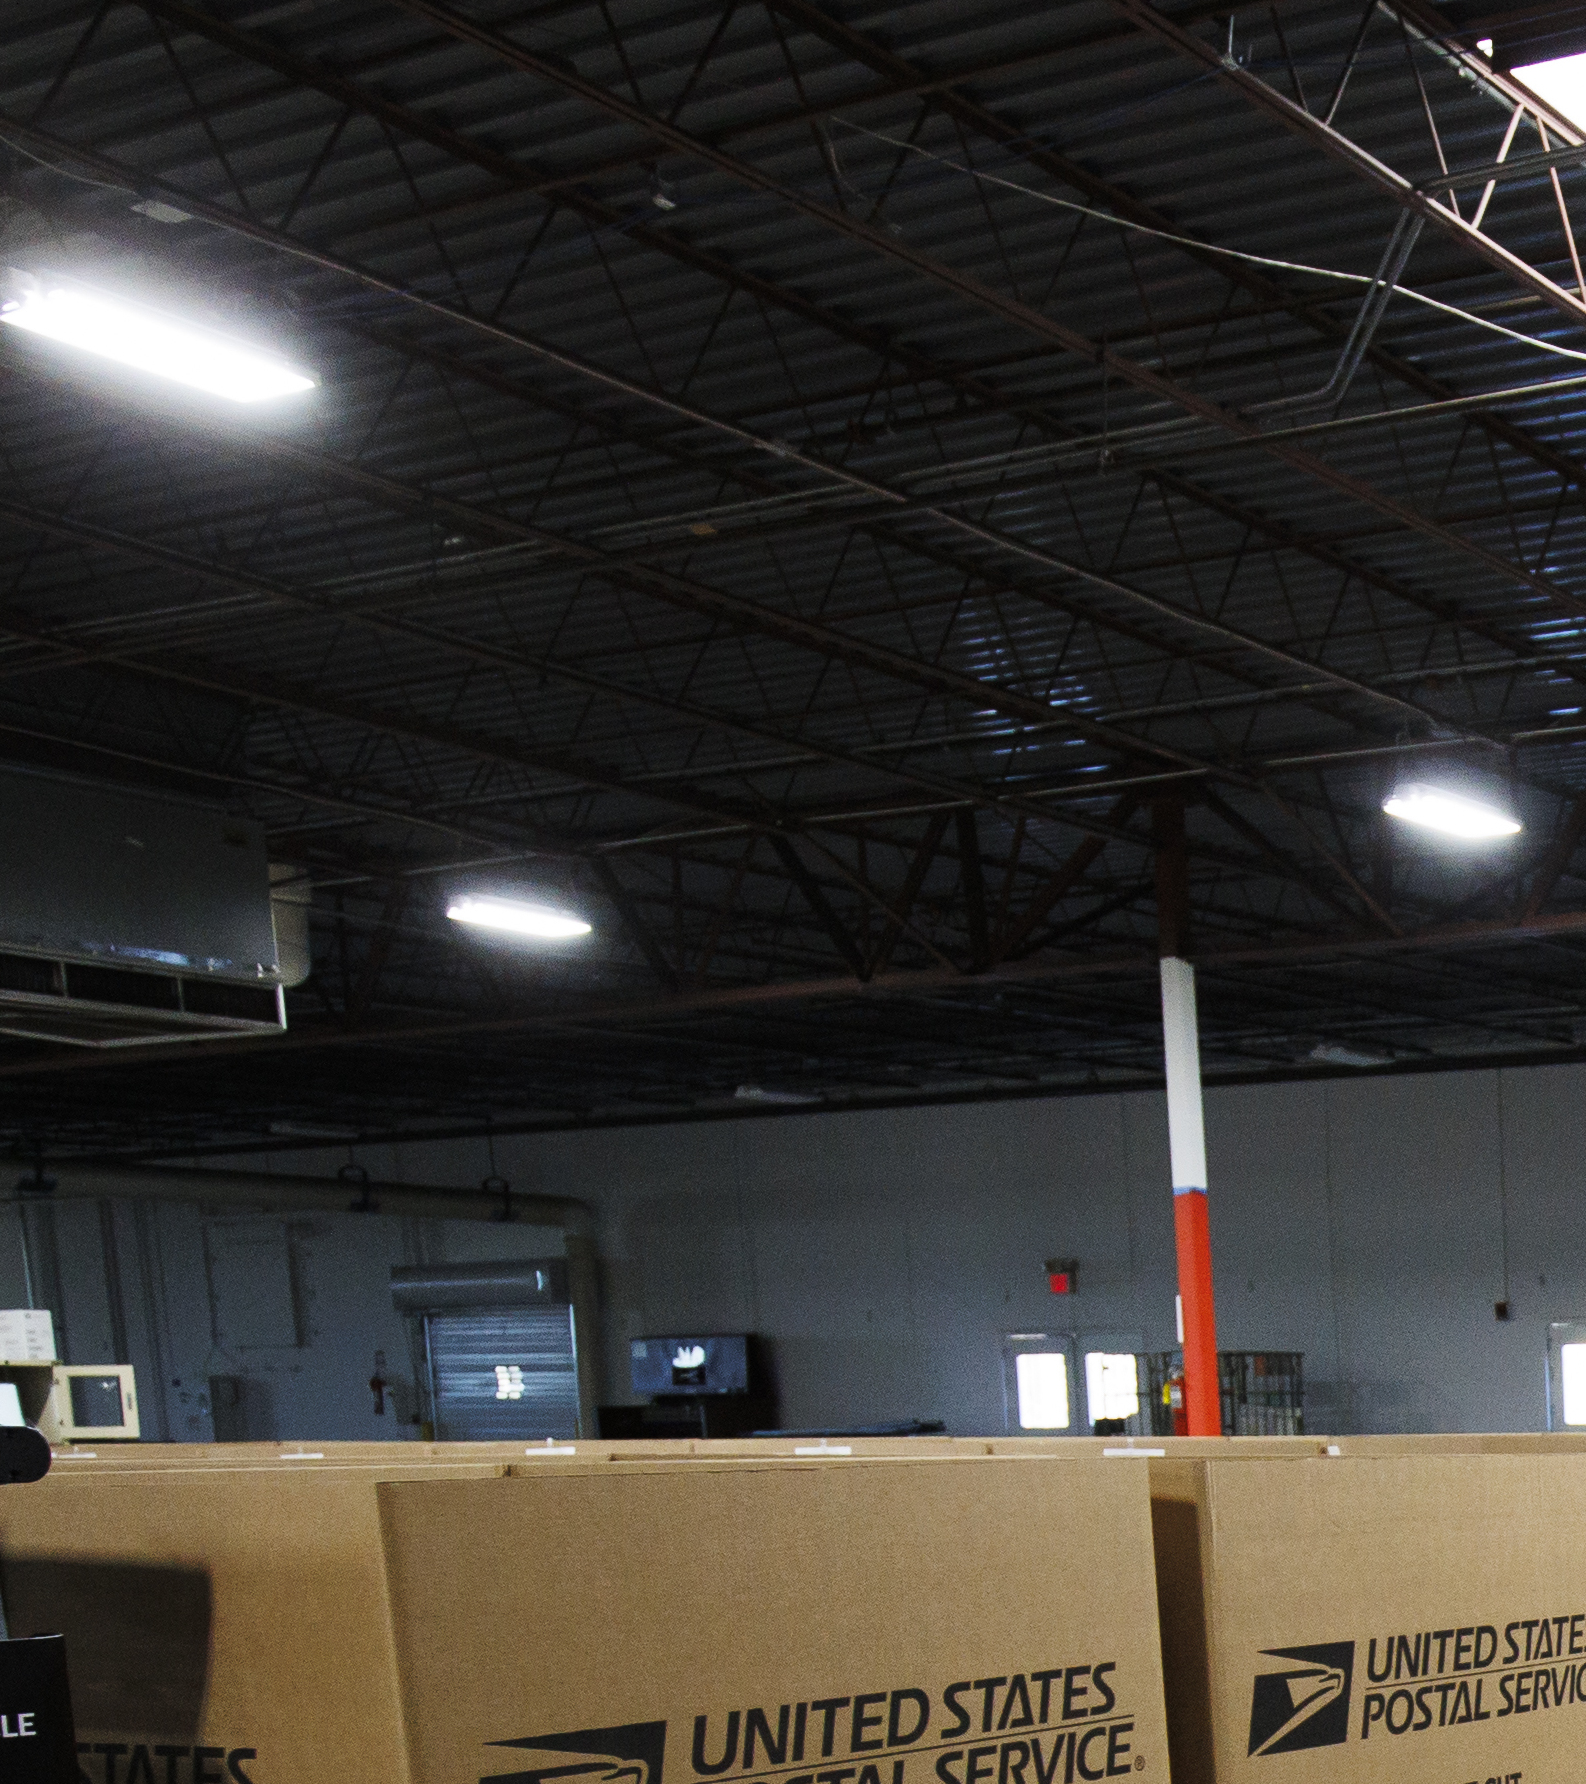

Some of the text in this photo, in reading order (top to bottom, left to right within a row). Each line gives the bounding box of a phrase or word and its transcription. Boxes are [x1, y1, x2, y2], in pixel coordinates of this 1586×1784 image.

[1367, 1624, 1498, 1683] UNITED
[690, 1661, 1117, 1776] UNITED STATES
[1361, 1678, 1491, 1740] POSTAL
